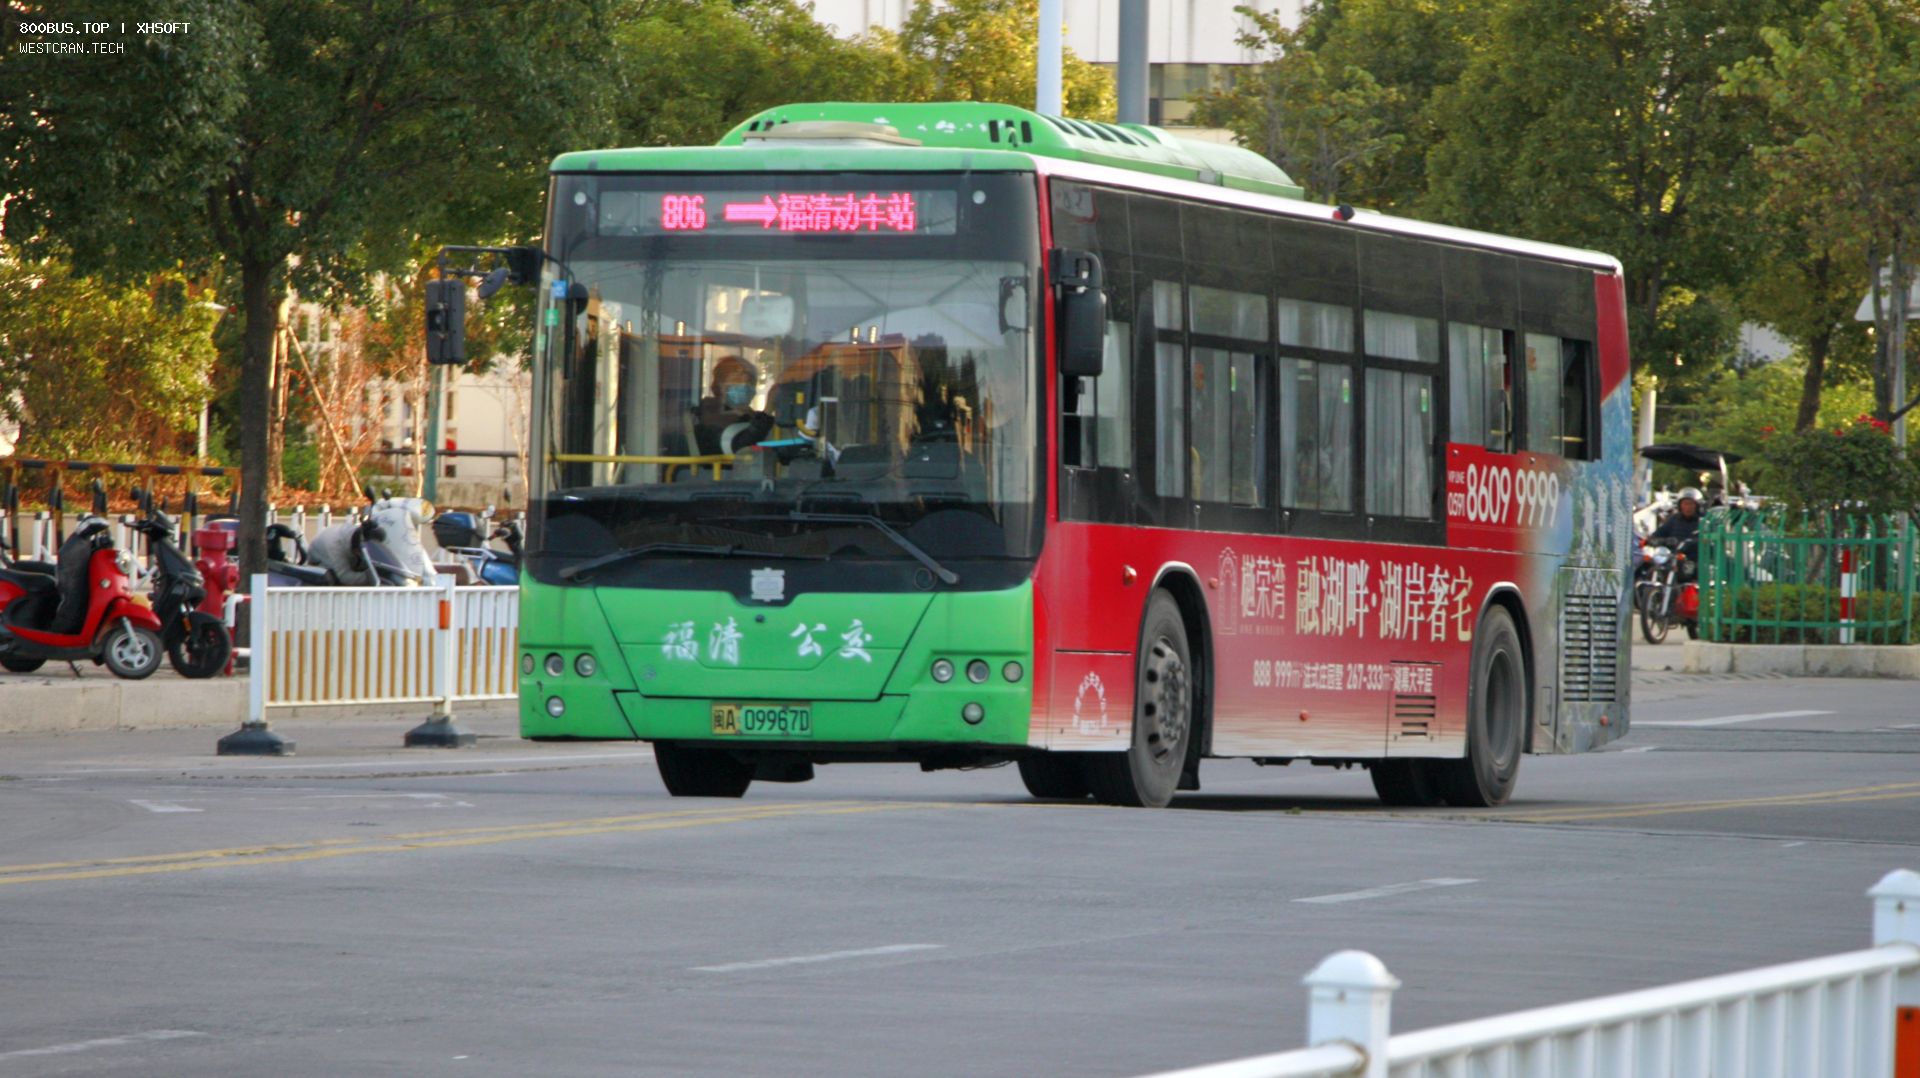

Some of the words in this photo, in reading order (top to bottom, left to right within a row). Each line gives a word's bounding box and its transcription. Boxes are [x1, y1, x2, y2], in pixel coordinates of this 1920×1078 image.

[662, 194, 705, 230] 806
[778, 192, 916, 232] 福清动车站
[1466, 463, 1511, 524] 8609
[1515, 468, 1560, 528] 9999
[661, 616, 743, 666] 福清
[790, 618, 873, 664] 公交
[1253, 659, 1271, 688] 888
[744, 708, 810, 732] 09967D
